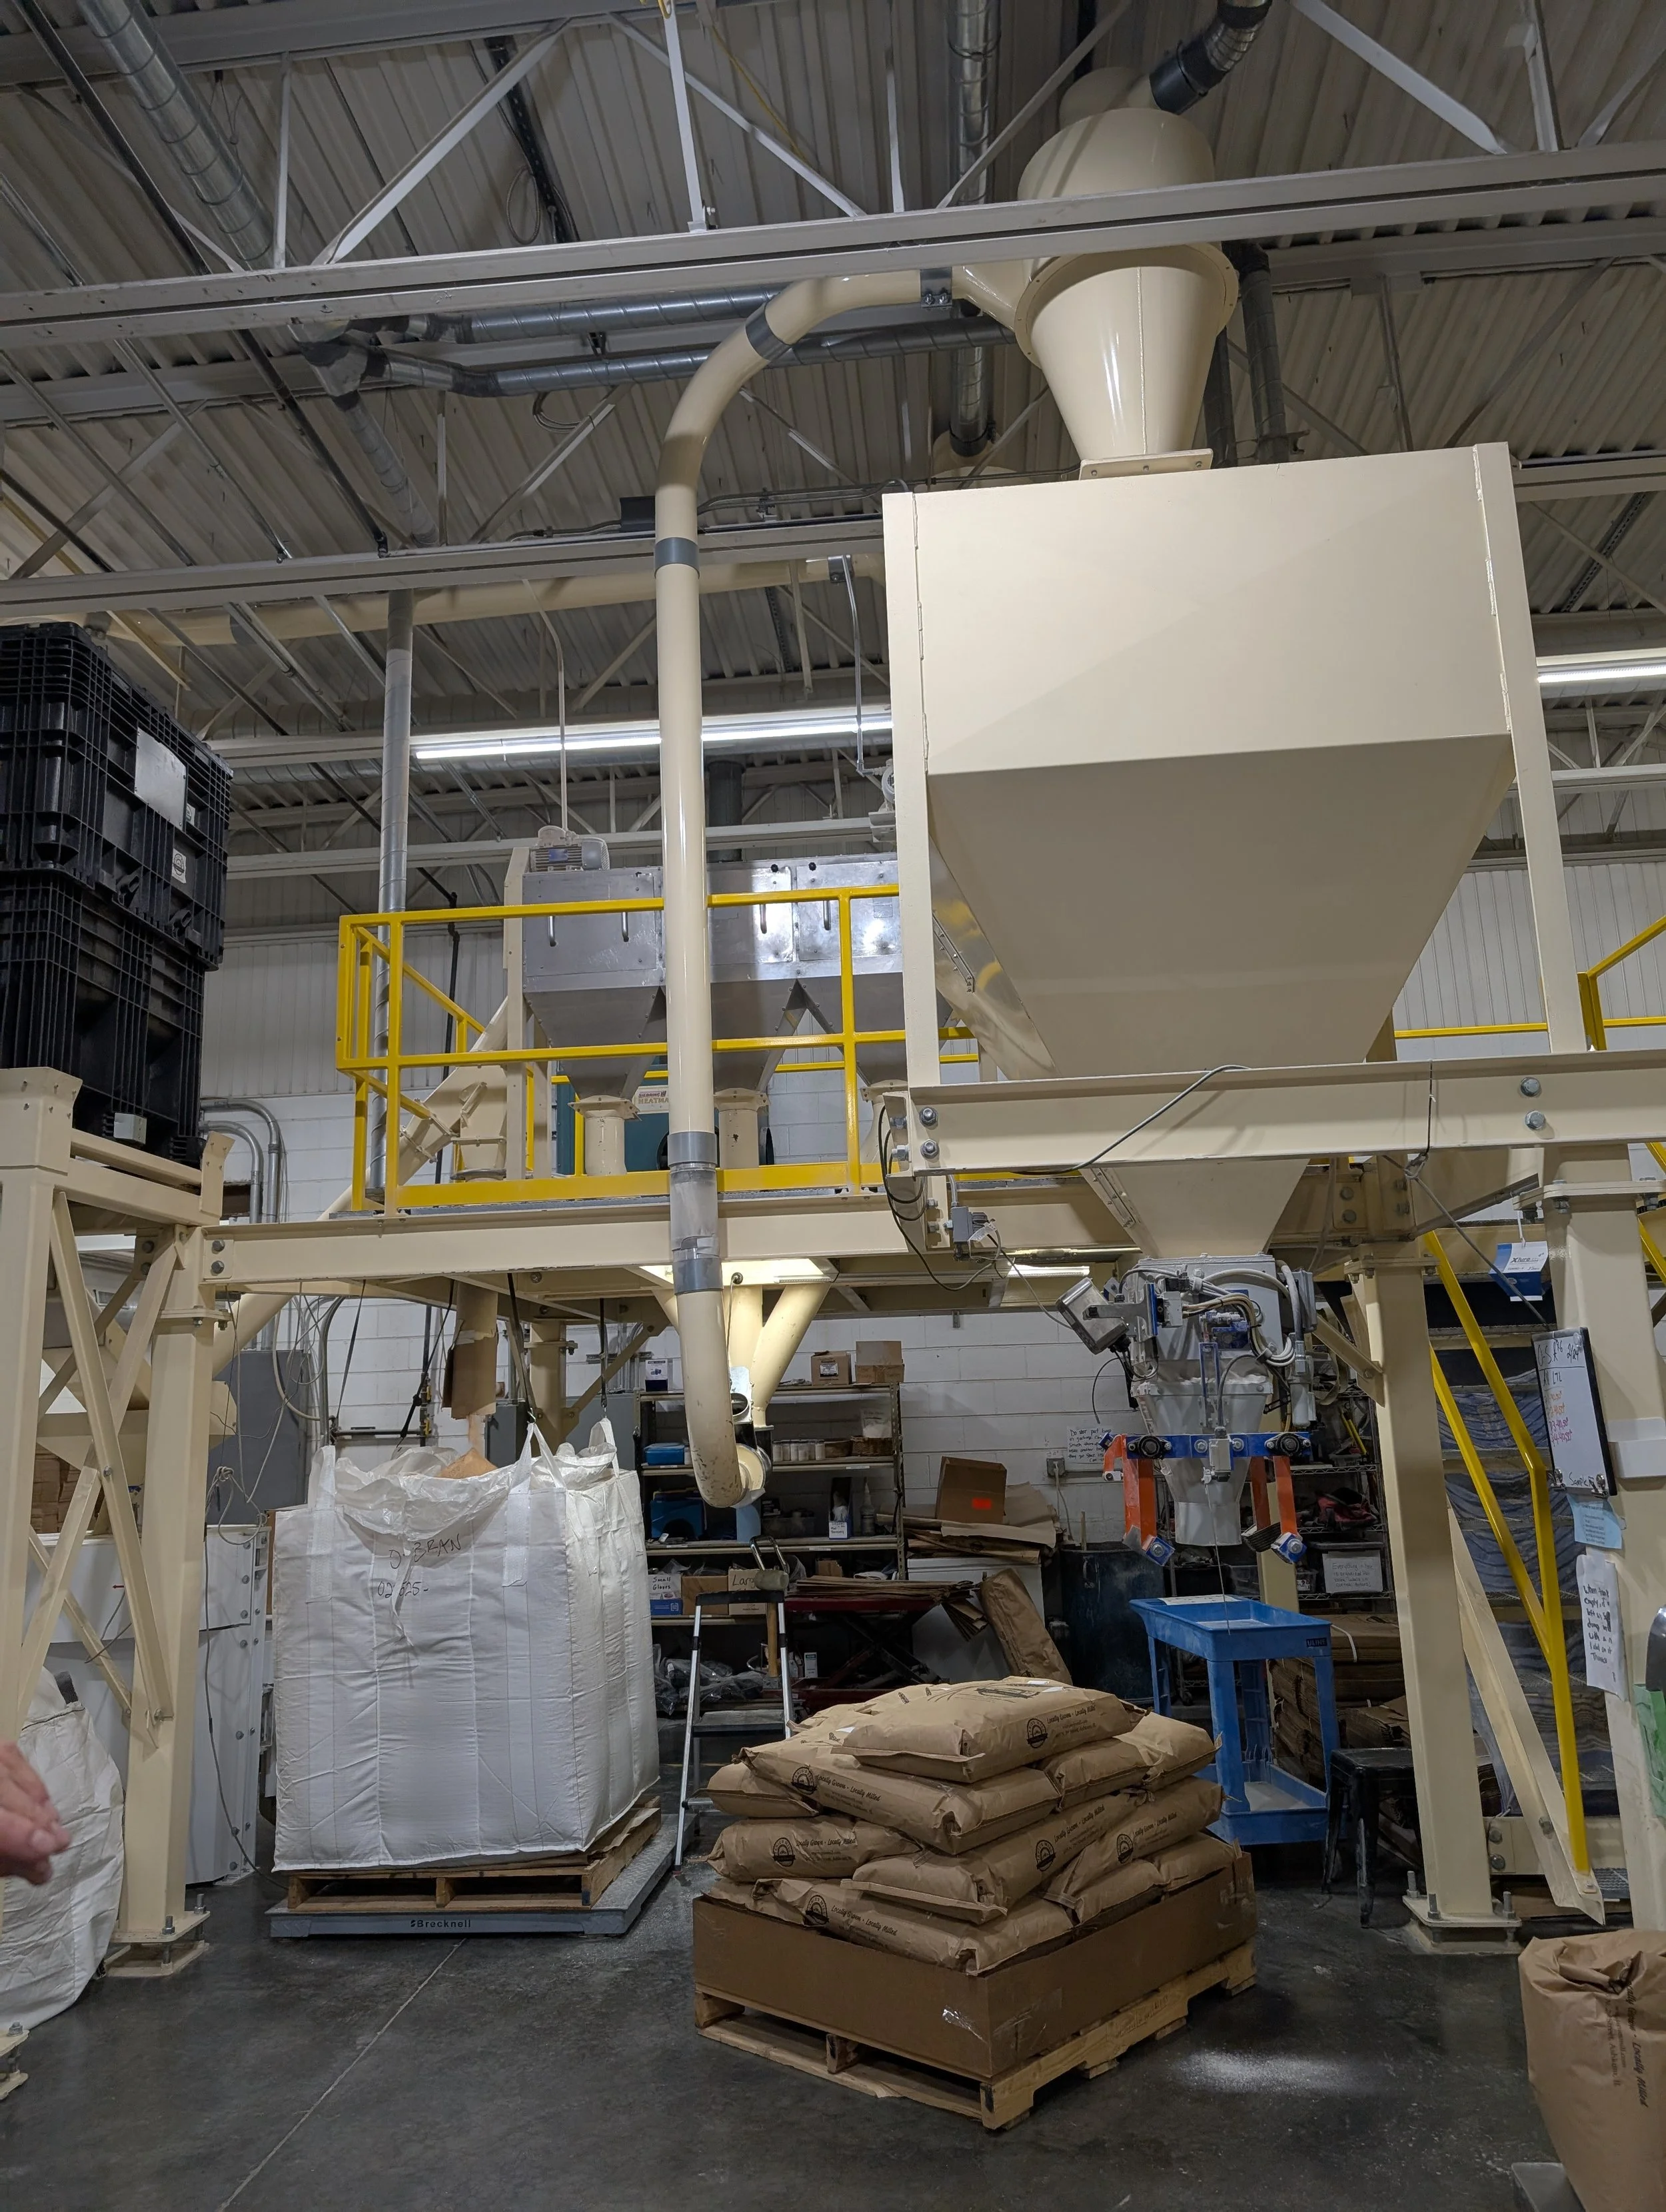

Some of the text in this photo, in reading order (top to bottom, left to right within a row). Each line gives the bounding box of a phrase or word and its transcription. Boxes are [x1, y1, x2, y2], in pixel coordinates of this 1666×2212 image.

[732, 1574, 755, 1588] Larg
[1047, 1715, 1059, 1724] Locally
[832, 1780, 846, 1789] Grown
[850, 1786, 865, 1798] Locally
[866, 1792, 880, 1801] Milled
[1054, 1830, 1066, 1844] Locally
[1066, 1822, 1078, 1834] Grown
[1081, 1812, 1094, 1825] Locally
[1094, 1804, 1105, 1817] Milled
[1157, 1816, 1168, 1826] Locally
[831, 1905, 846, 1917] Locally
[847, 1911, 862, 1922] Grown
[866, 1919, 882, 1930] Locally
[882, 1925, 898, 1936] Milled
[1627, 2007, 1637, 2031] Grown
[1633, 2041, 1645, 2075] Locally
[1637, 2075, 1649, 2108] Milled
